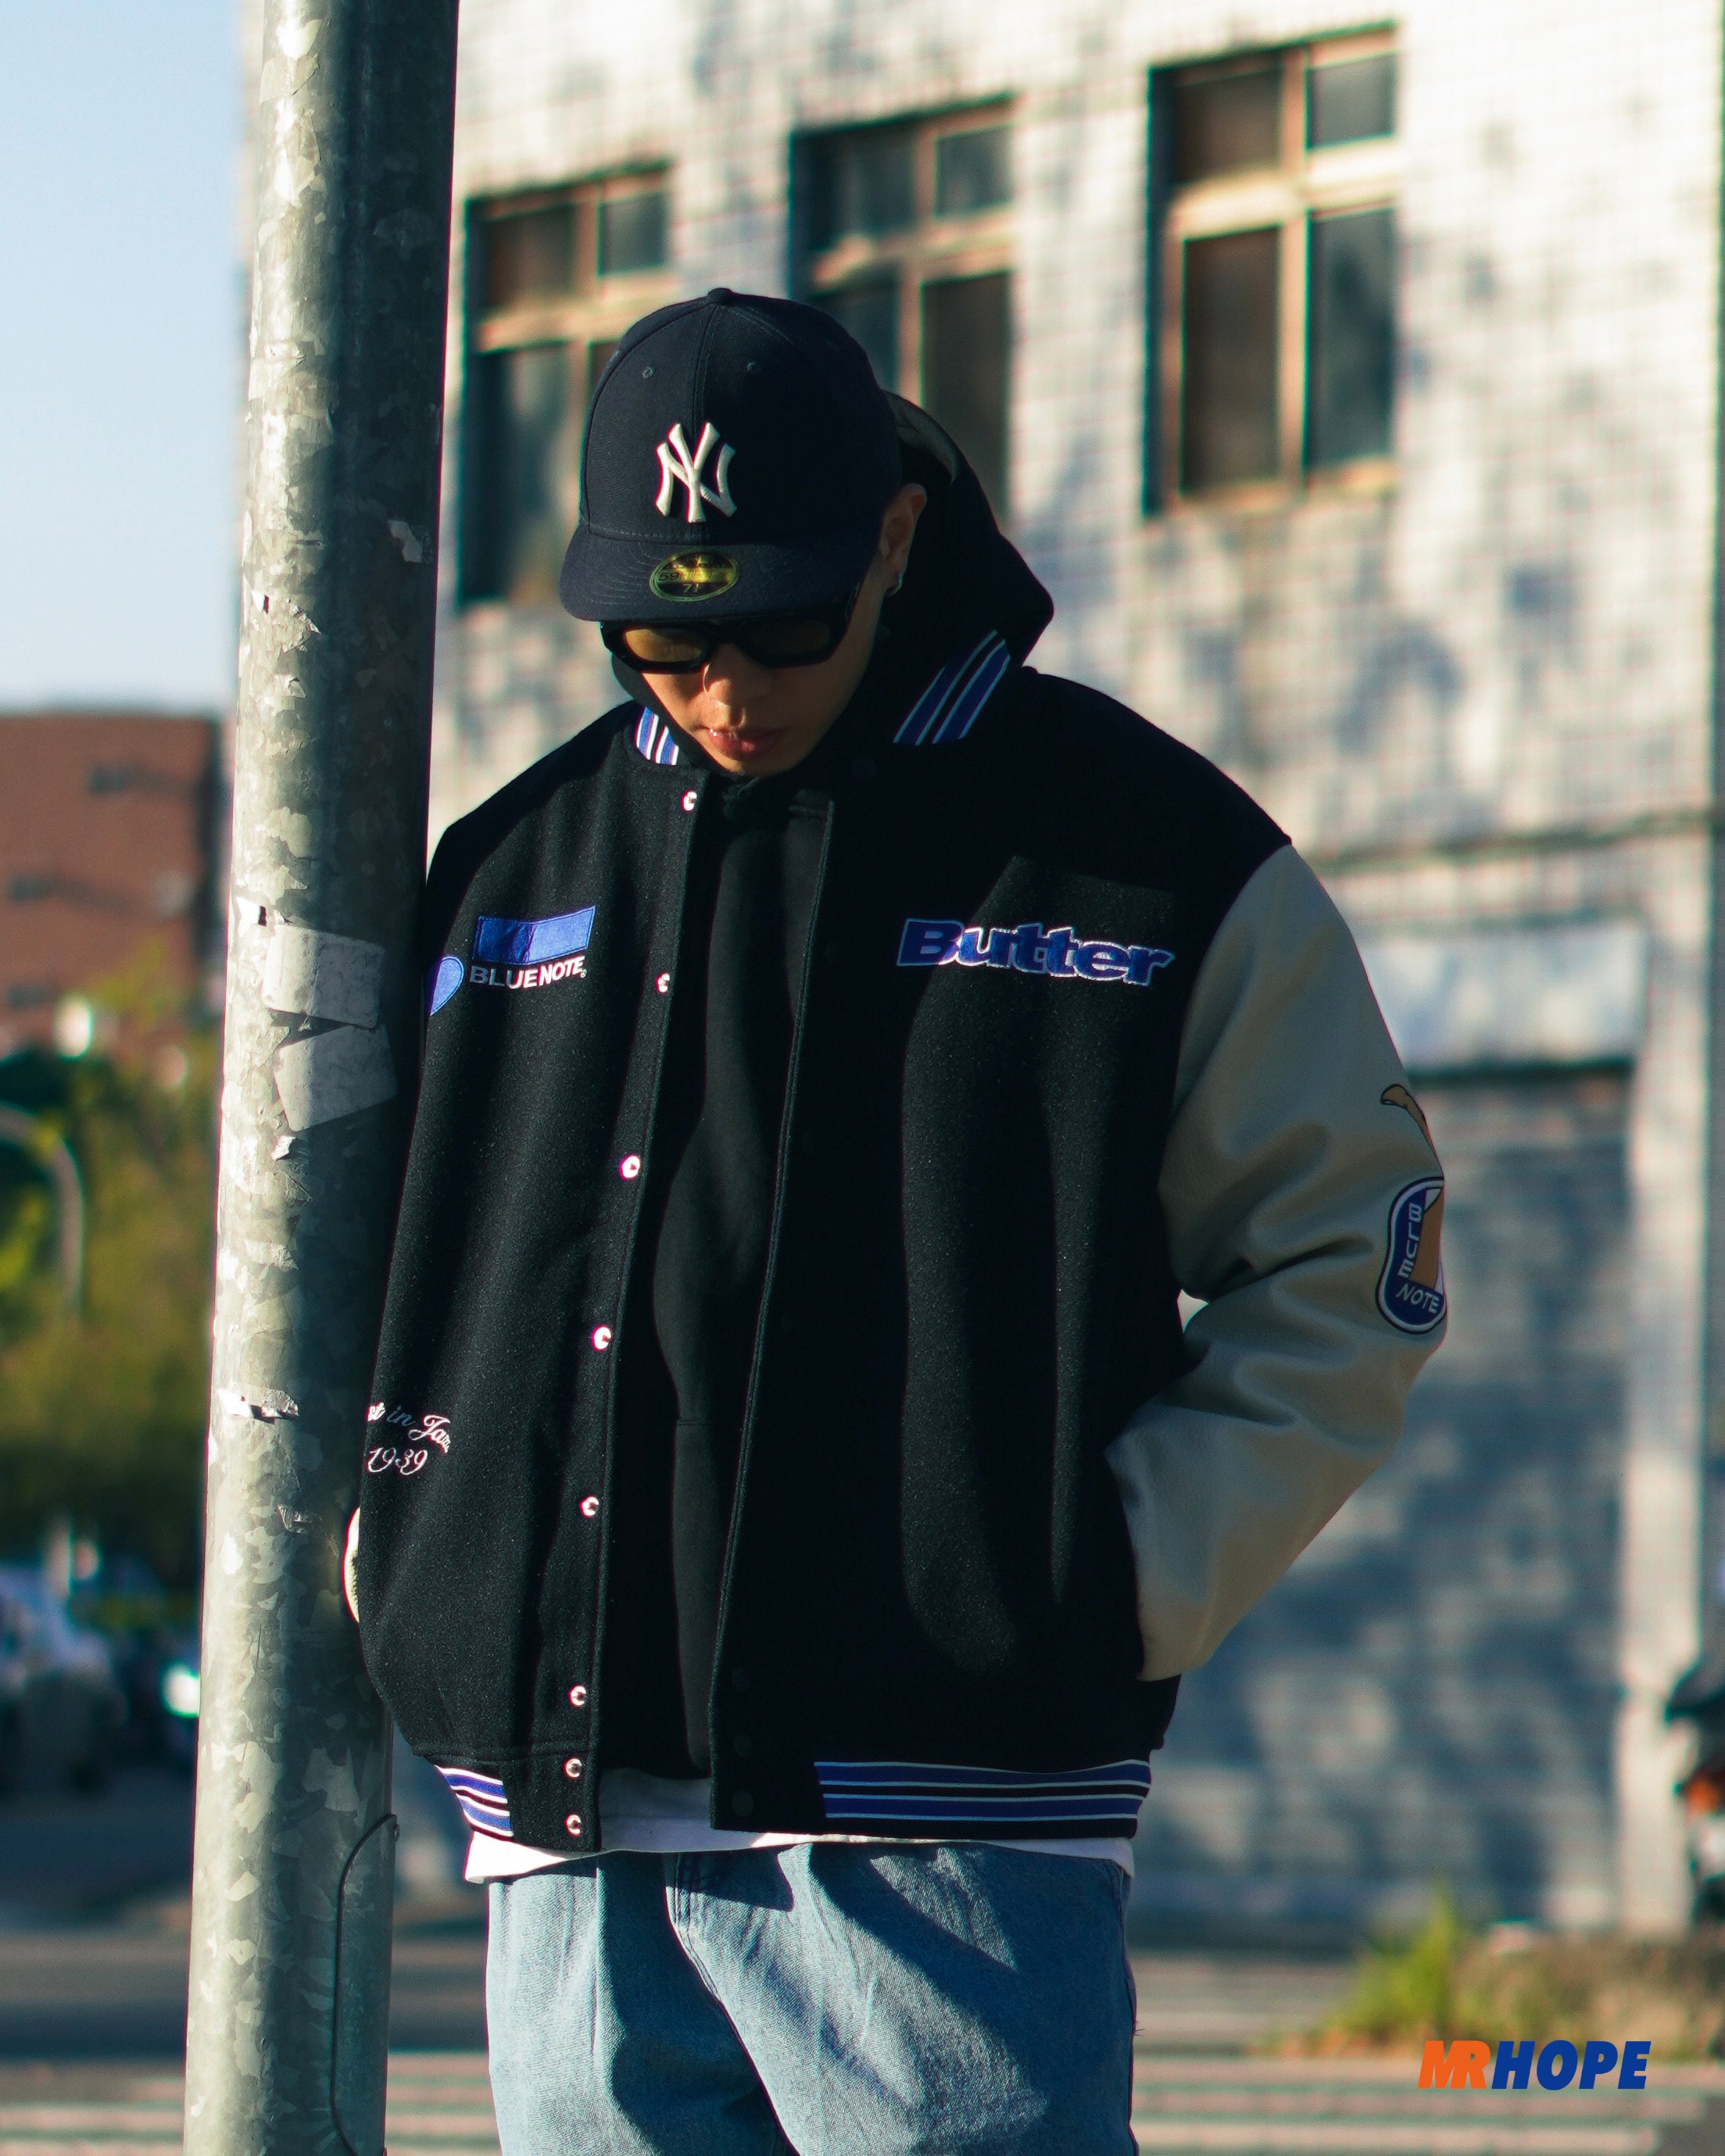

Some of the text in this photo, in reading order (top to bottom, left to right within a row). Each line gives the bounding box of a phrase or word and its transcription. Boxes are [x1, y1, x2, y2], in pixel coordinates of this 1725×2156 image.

[656, 422, 737, 523] NY
[896, 918, 1175, 986] Butter
[1397, 1203, 1422, 1278] BLUE
[1395, 1283, 1440, 1314] NOTE
[386, 1404, 417, 1427] in
[367, 1447, 428, 1475] 1939
